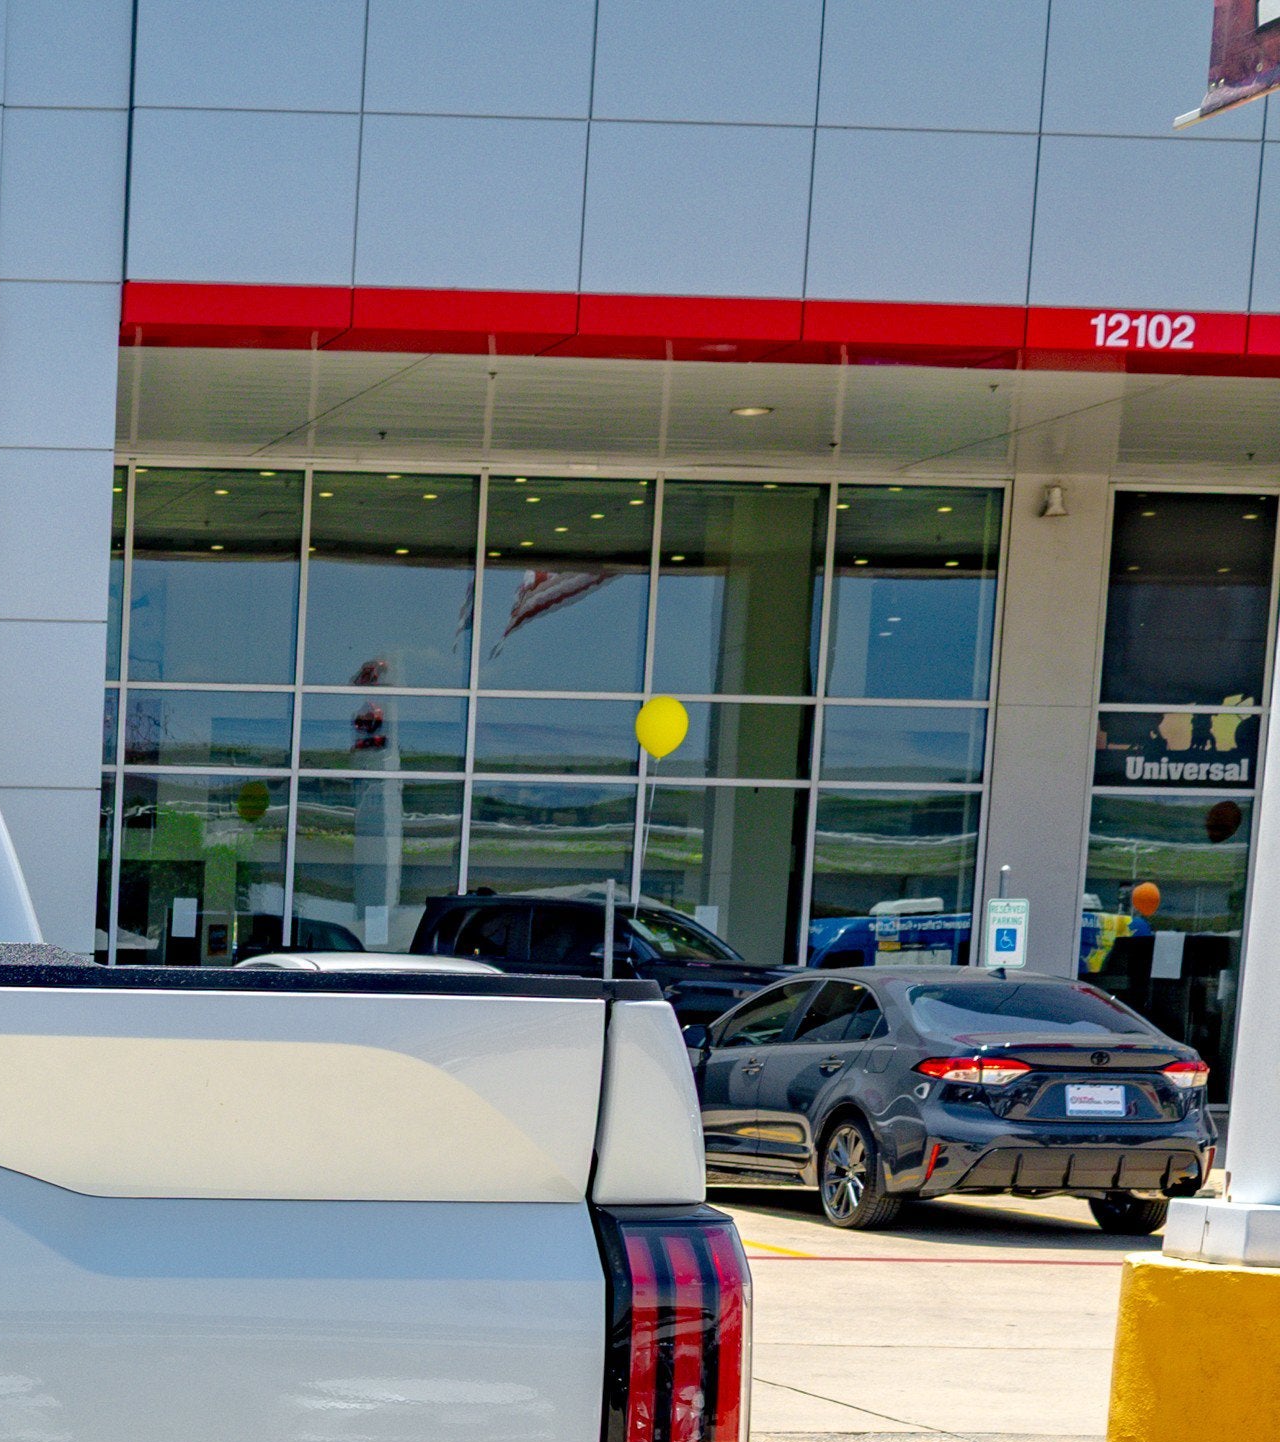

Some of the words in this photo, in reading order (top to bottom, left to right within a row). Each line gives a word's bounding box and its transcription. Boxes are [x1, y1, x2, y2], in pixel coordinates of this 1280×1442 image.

[1090, 313, 1196, 350] 12102
[1125, 756, 1249, 782] Universal
[992, 916, 1023, 925] PARKING
